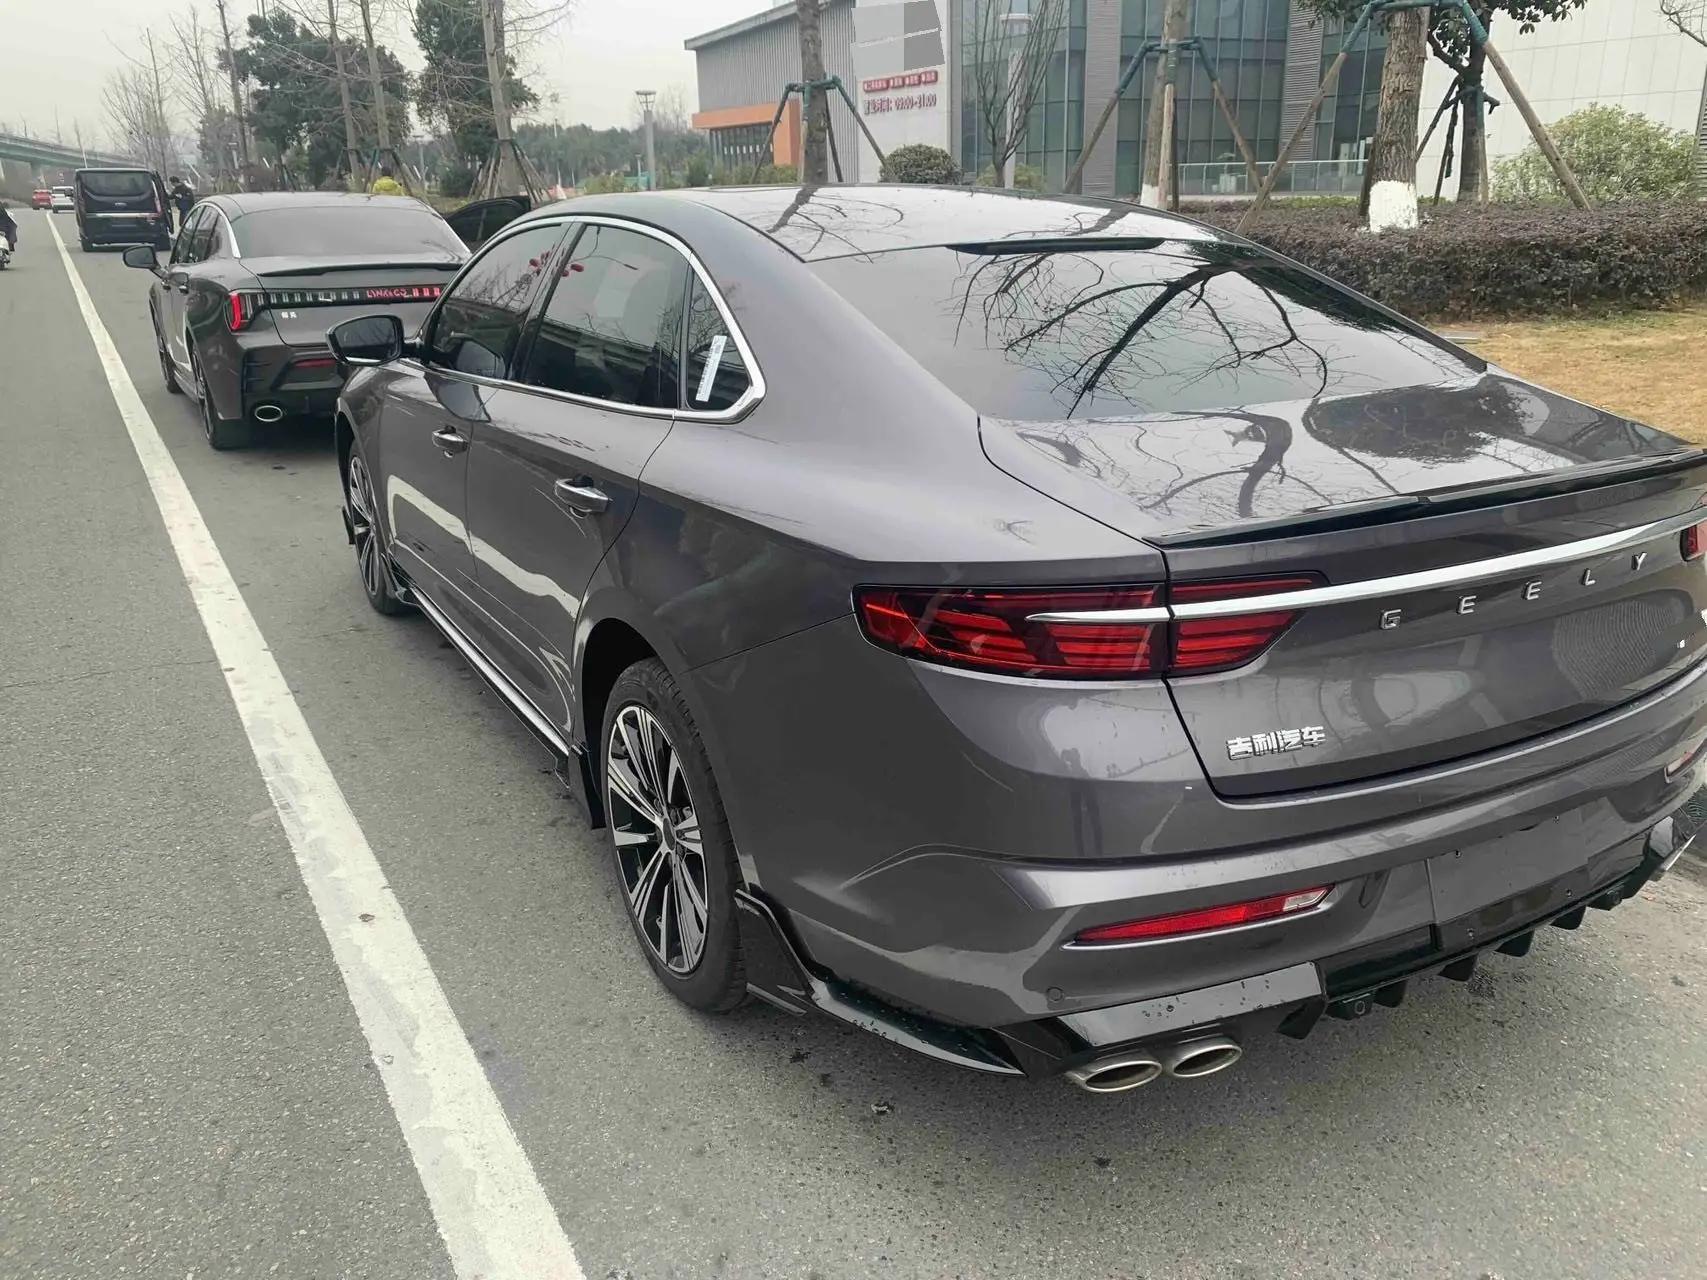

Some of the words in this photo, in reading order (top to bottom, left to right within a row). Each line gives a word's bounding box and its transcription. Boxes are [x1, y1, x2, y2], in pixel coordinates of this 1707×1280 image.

[1380, 552, 1648, 630] GEELY
[1226, 725, 1326, 760] 吉利汽车
